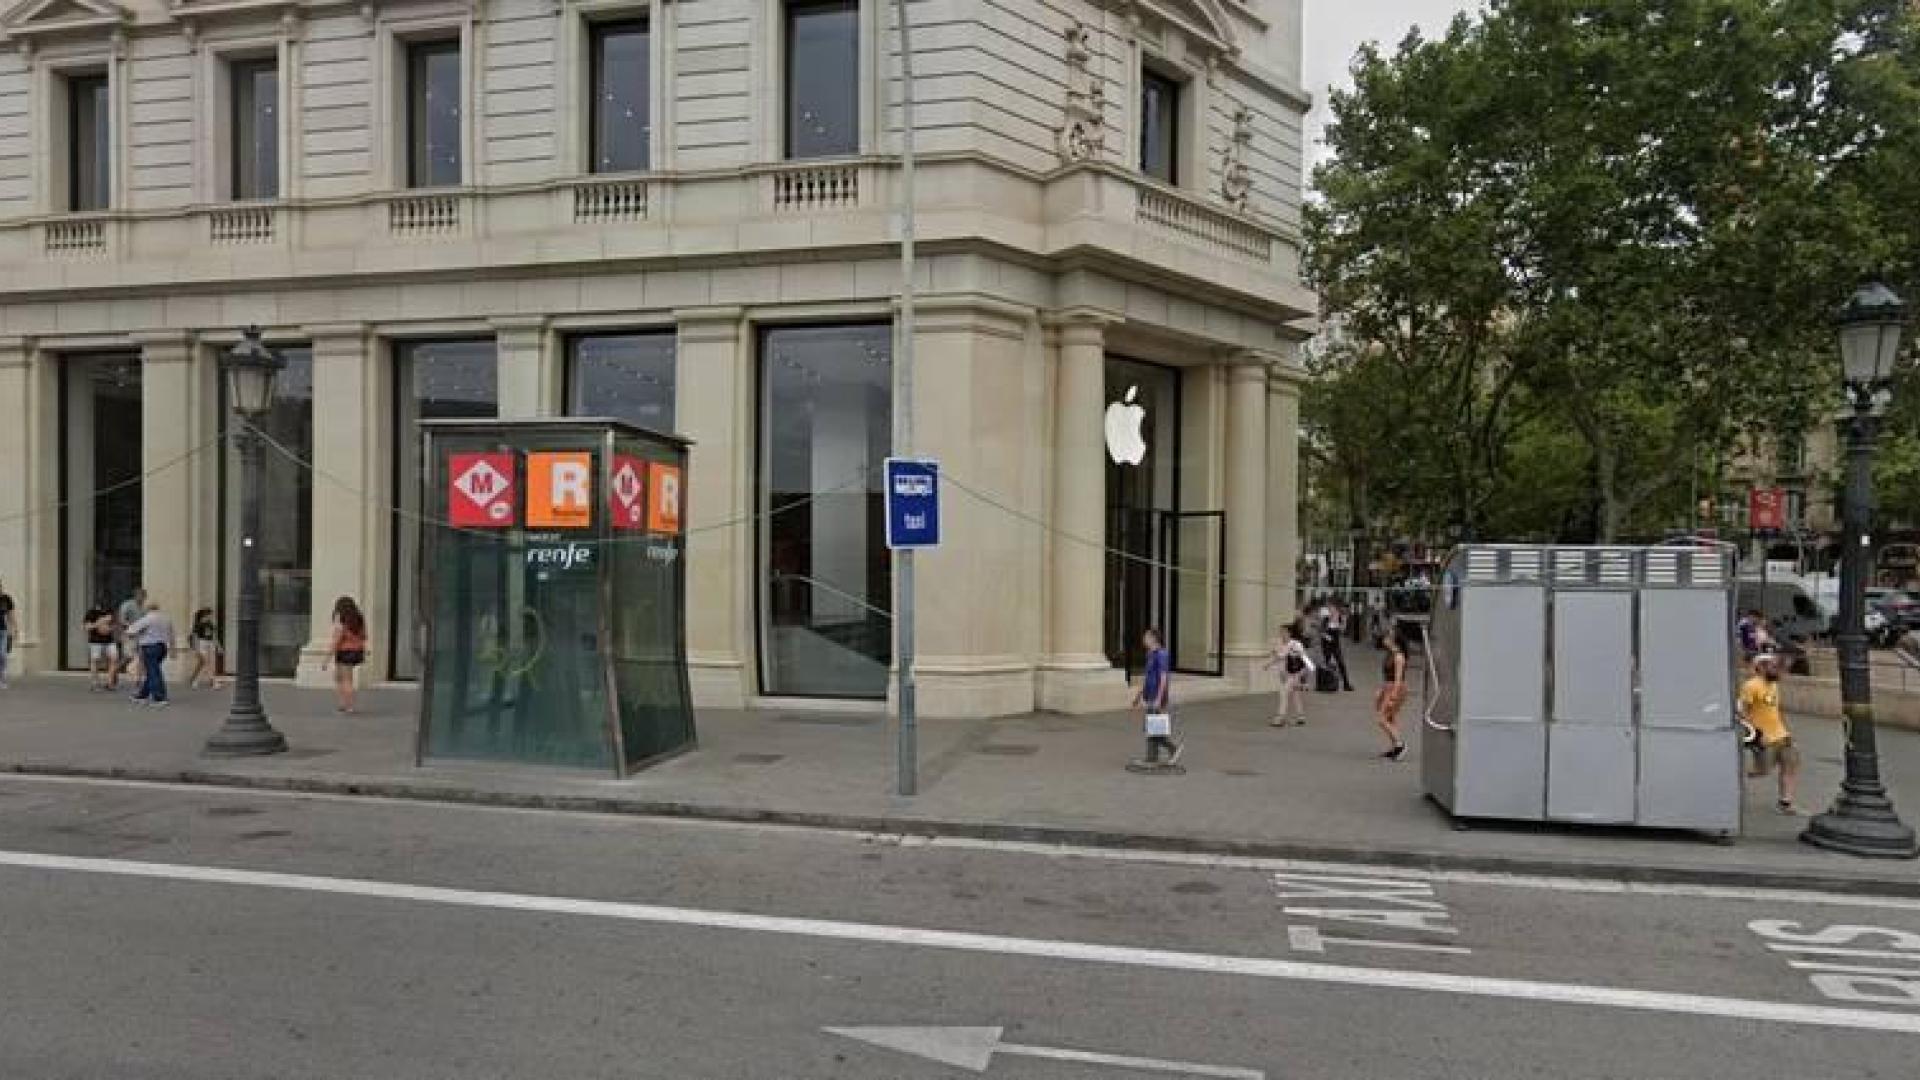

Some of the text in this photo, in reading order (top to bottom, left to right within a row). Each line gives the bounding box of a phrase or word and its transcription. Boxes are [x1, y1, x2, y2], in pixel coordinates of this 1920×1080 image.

[470, 472, 494, 494] M
[552, 462, 590, 508] R
[526, 542, 591, 570] renfe
[1274, 872, 1473, 954] TAXI
